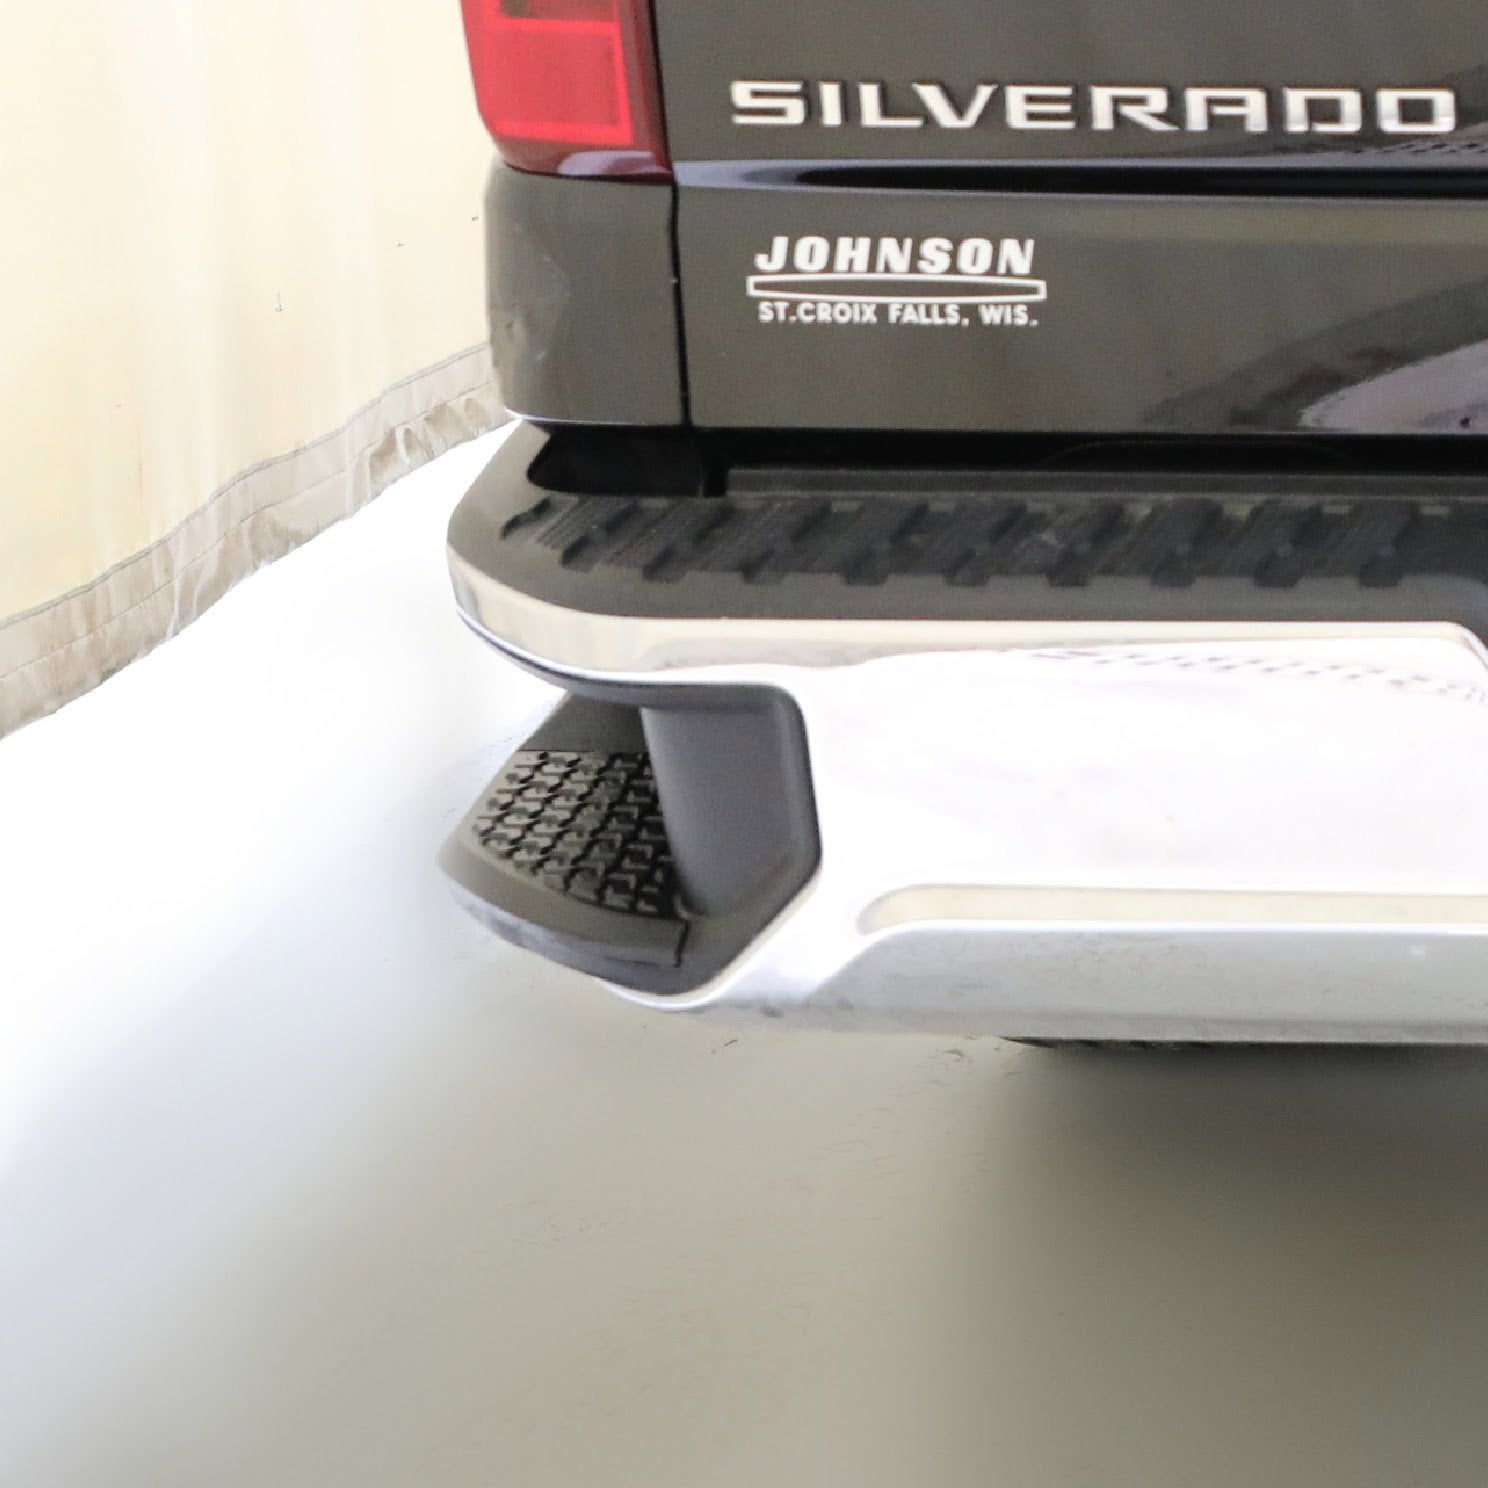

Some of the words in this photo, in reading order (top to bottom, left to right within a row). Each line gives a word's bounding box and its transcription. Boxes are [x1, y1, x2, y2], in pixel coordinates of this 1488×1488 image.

[730, 80, 1458, 135] SILVERADO
[754, 235, 1035, 275] JOHNSON
[978, 305, 1039, 327] WIS.
